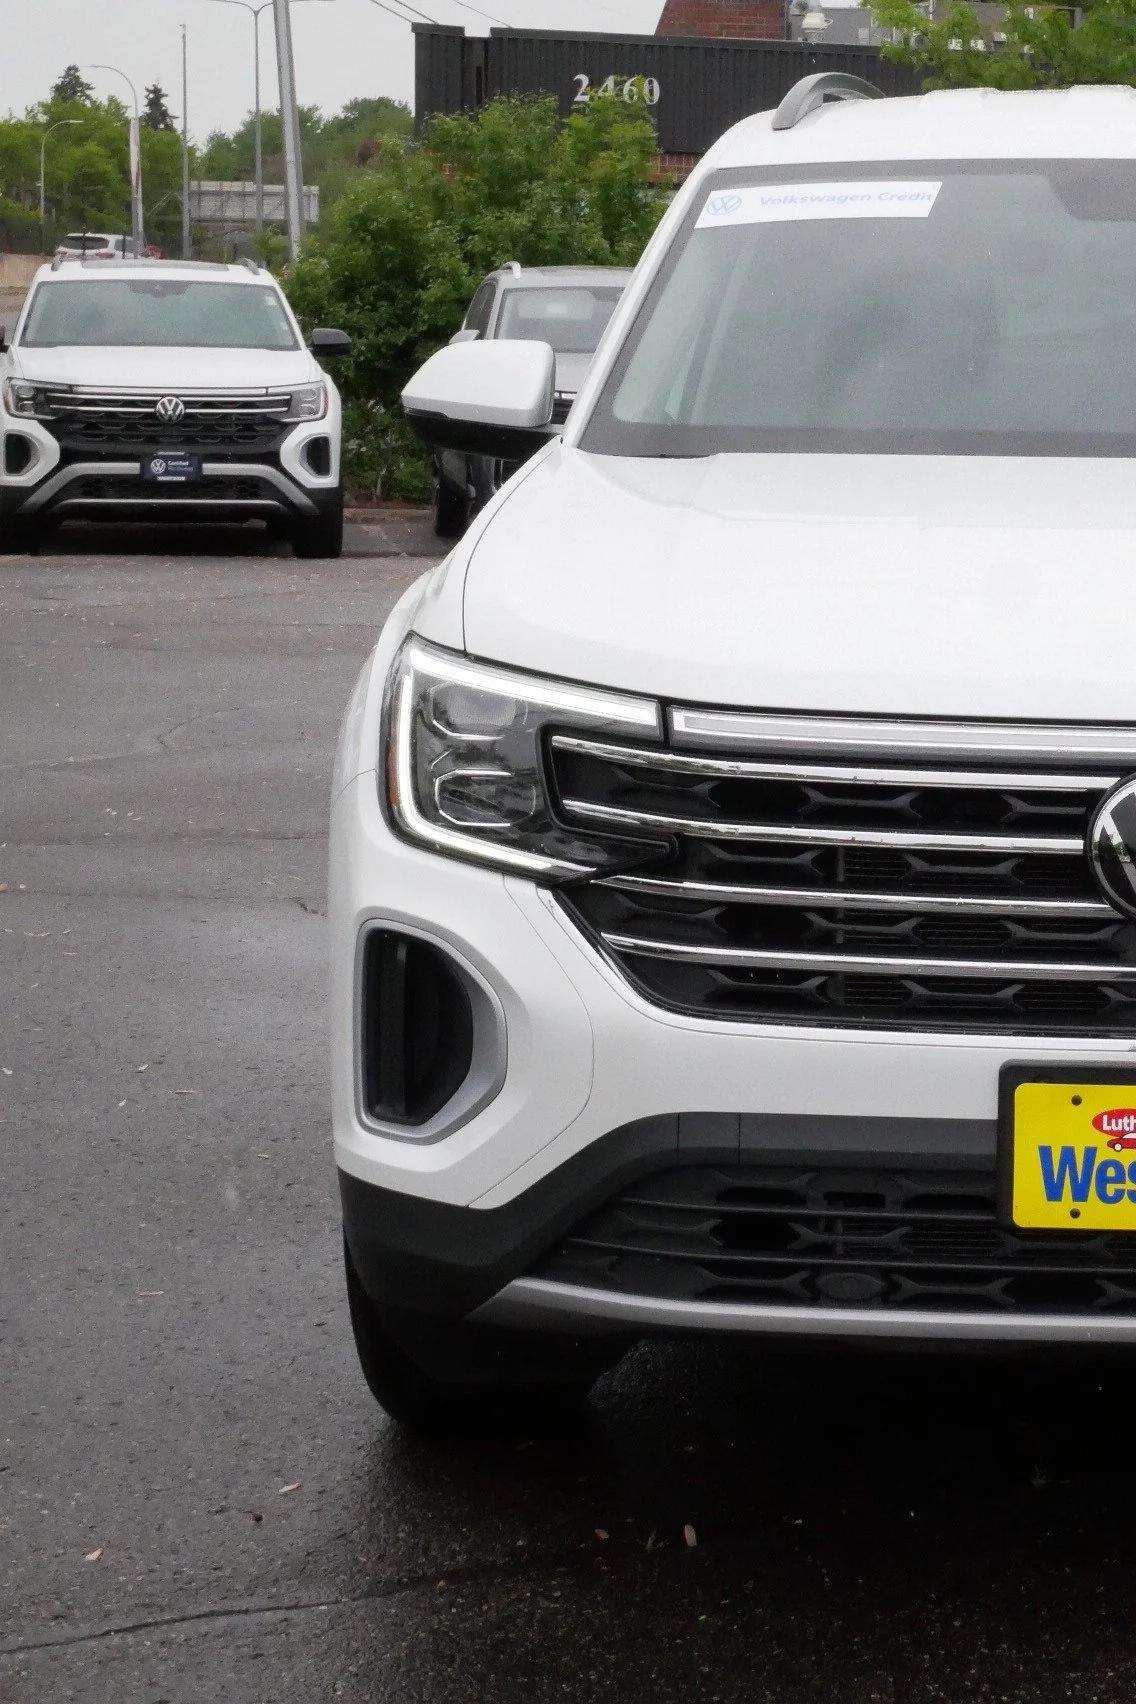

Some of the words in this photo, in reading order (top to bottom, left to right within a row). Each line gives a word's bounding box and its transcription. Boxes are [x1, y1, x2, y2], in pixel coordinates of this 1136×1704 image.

[573, 74, 660, 105] 2460
[760, 192, 872, 206] Volkswagen
[877, 192, 932, 202] Credit
